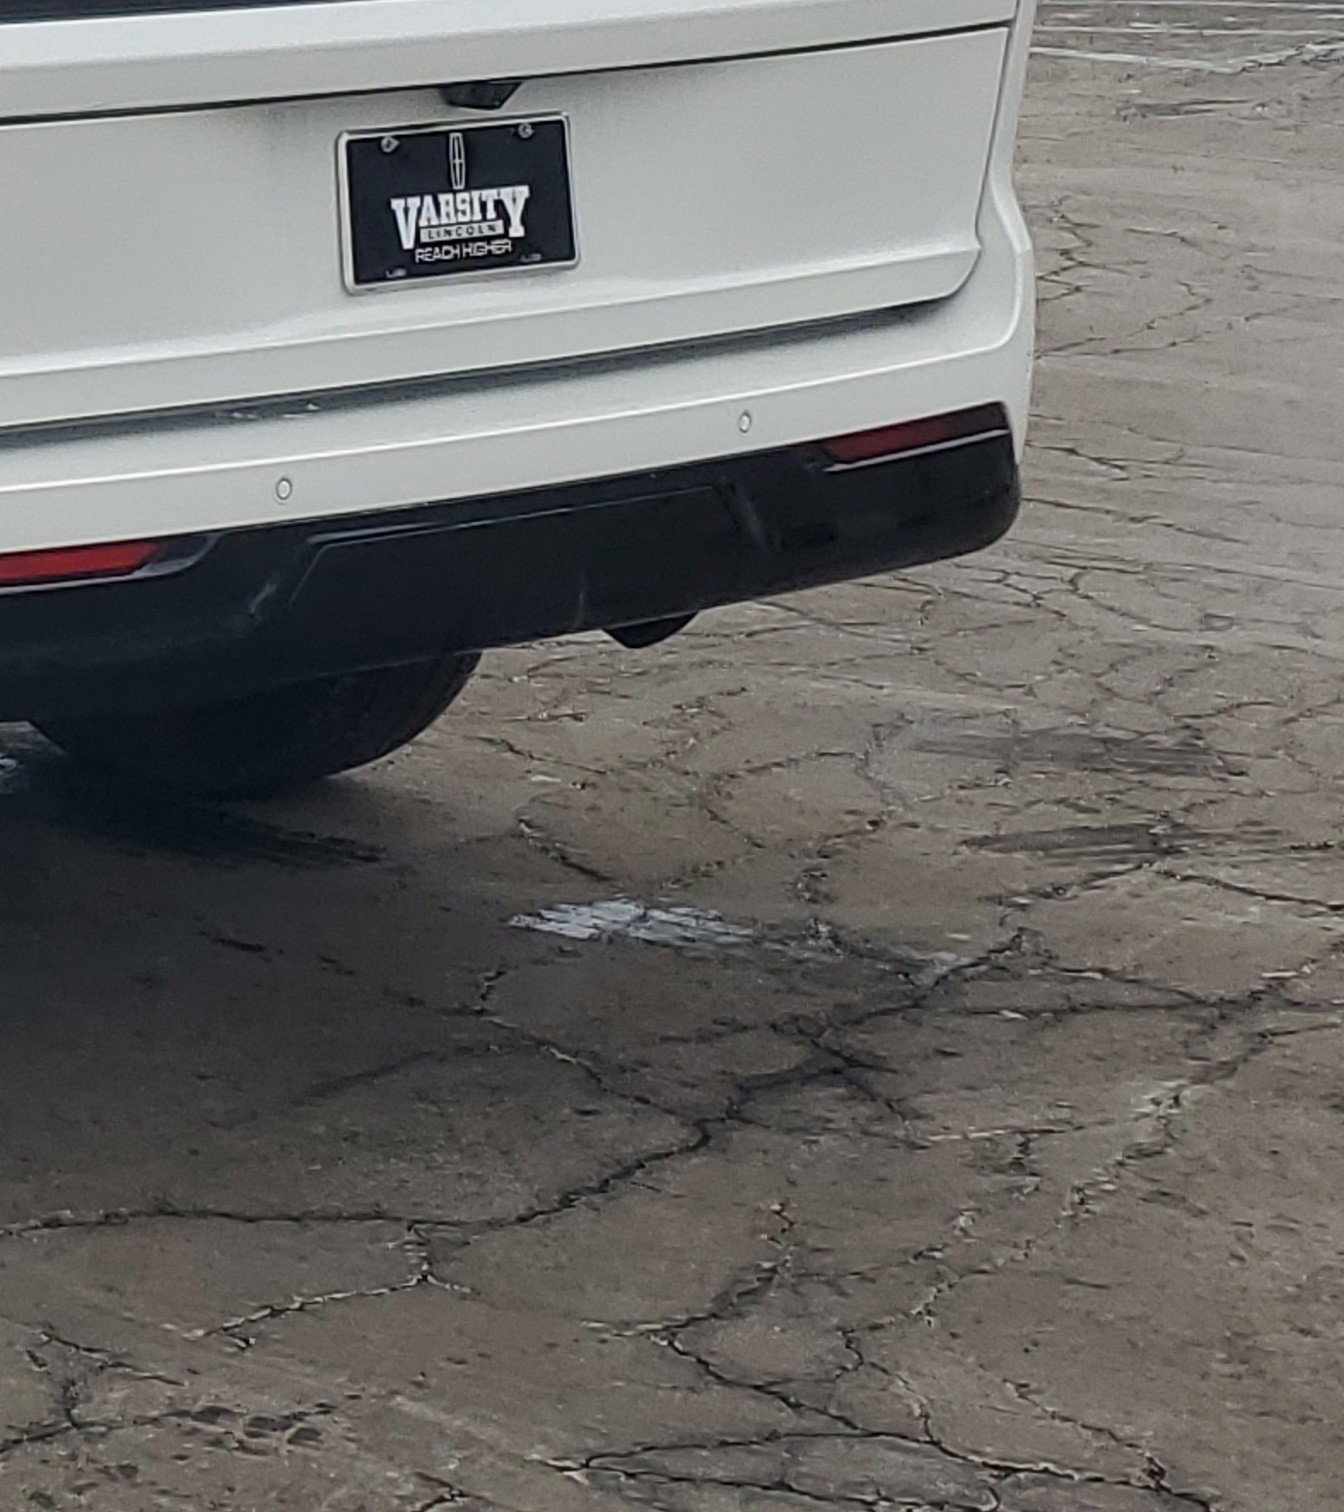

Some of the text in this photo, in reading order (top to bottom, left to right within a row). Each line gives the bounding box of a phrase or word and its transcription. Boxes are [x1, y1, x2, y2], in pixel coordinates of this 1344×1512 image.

[390, 185, 530, 250] VARSITY
[427, 223, 497, 240] LINCOLN
[415, 238, 512, 264] REACH HIGHER
